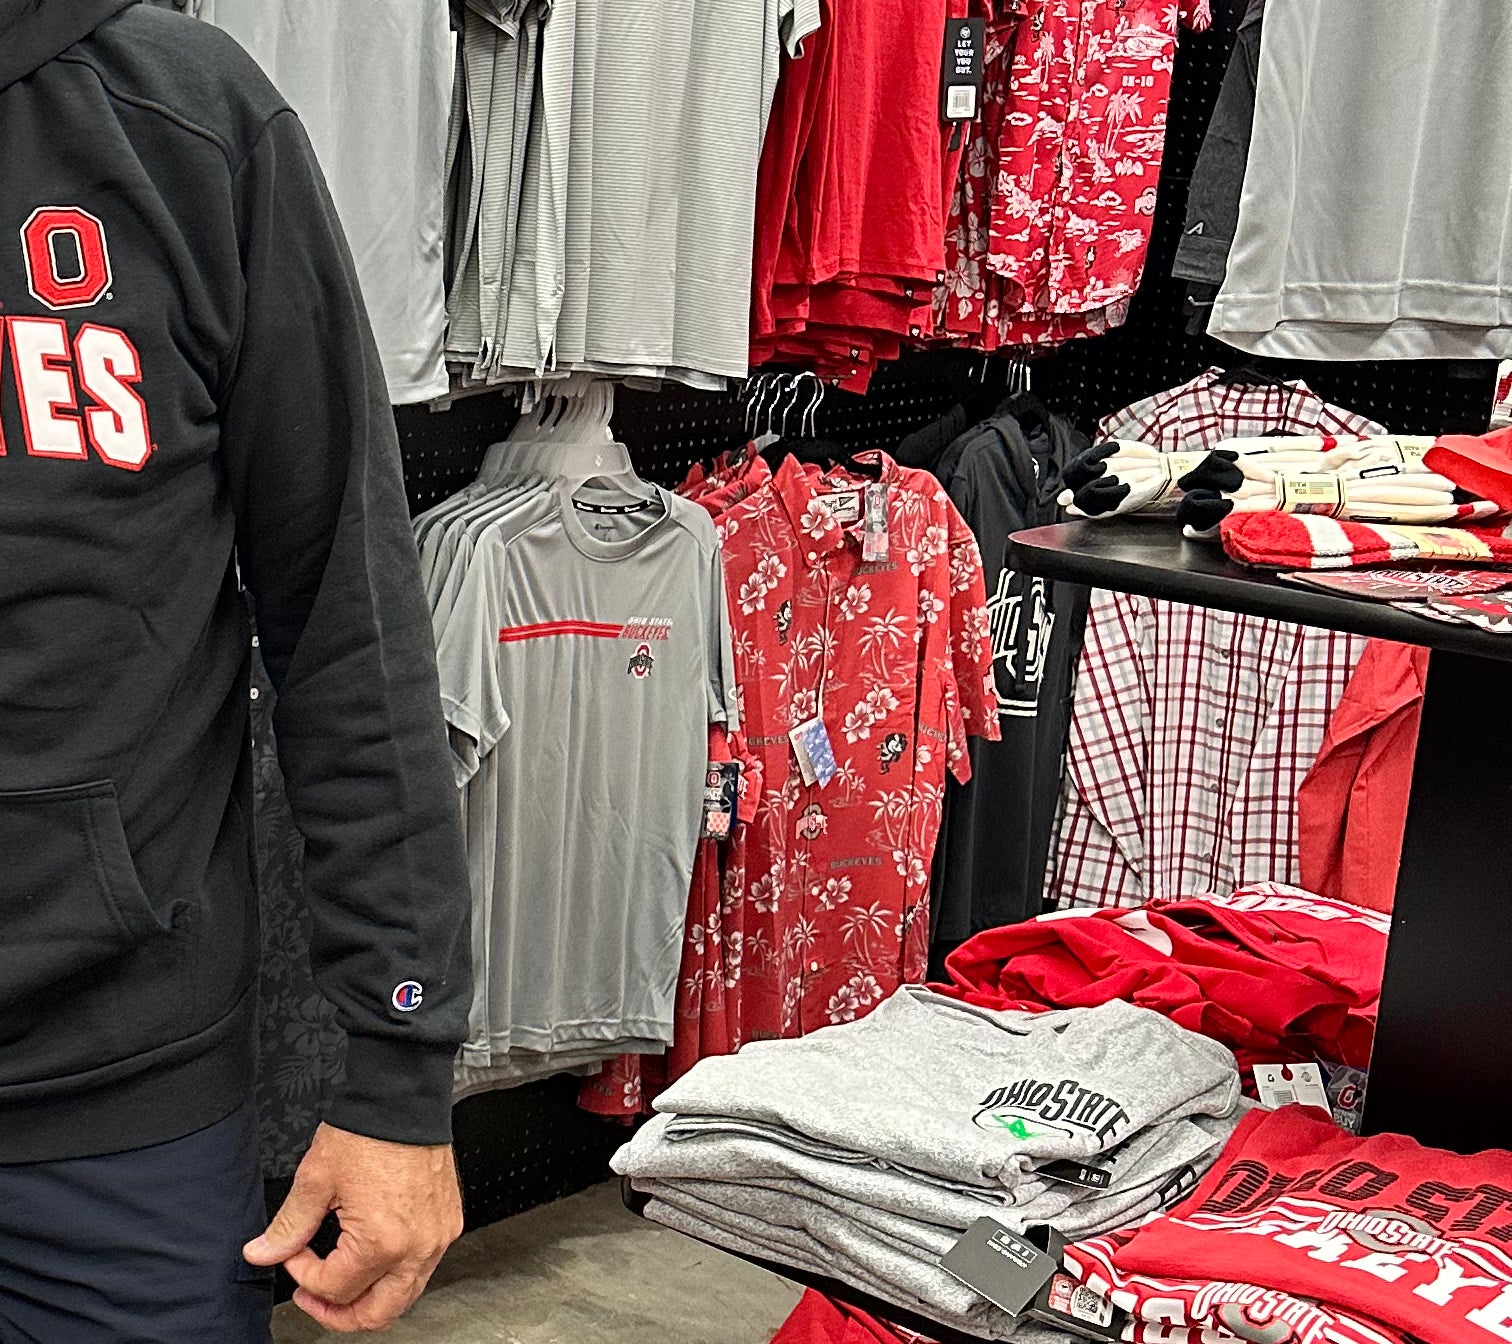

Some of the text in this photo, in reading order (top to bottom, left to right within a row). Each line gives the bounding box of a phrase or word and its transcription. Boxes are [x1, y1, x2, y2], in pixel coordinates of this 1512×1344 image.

[979, 1078, 1131, 1150] OHIO STATE
[1316, 1209, 1387, 1235] OHIO
